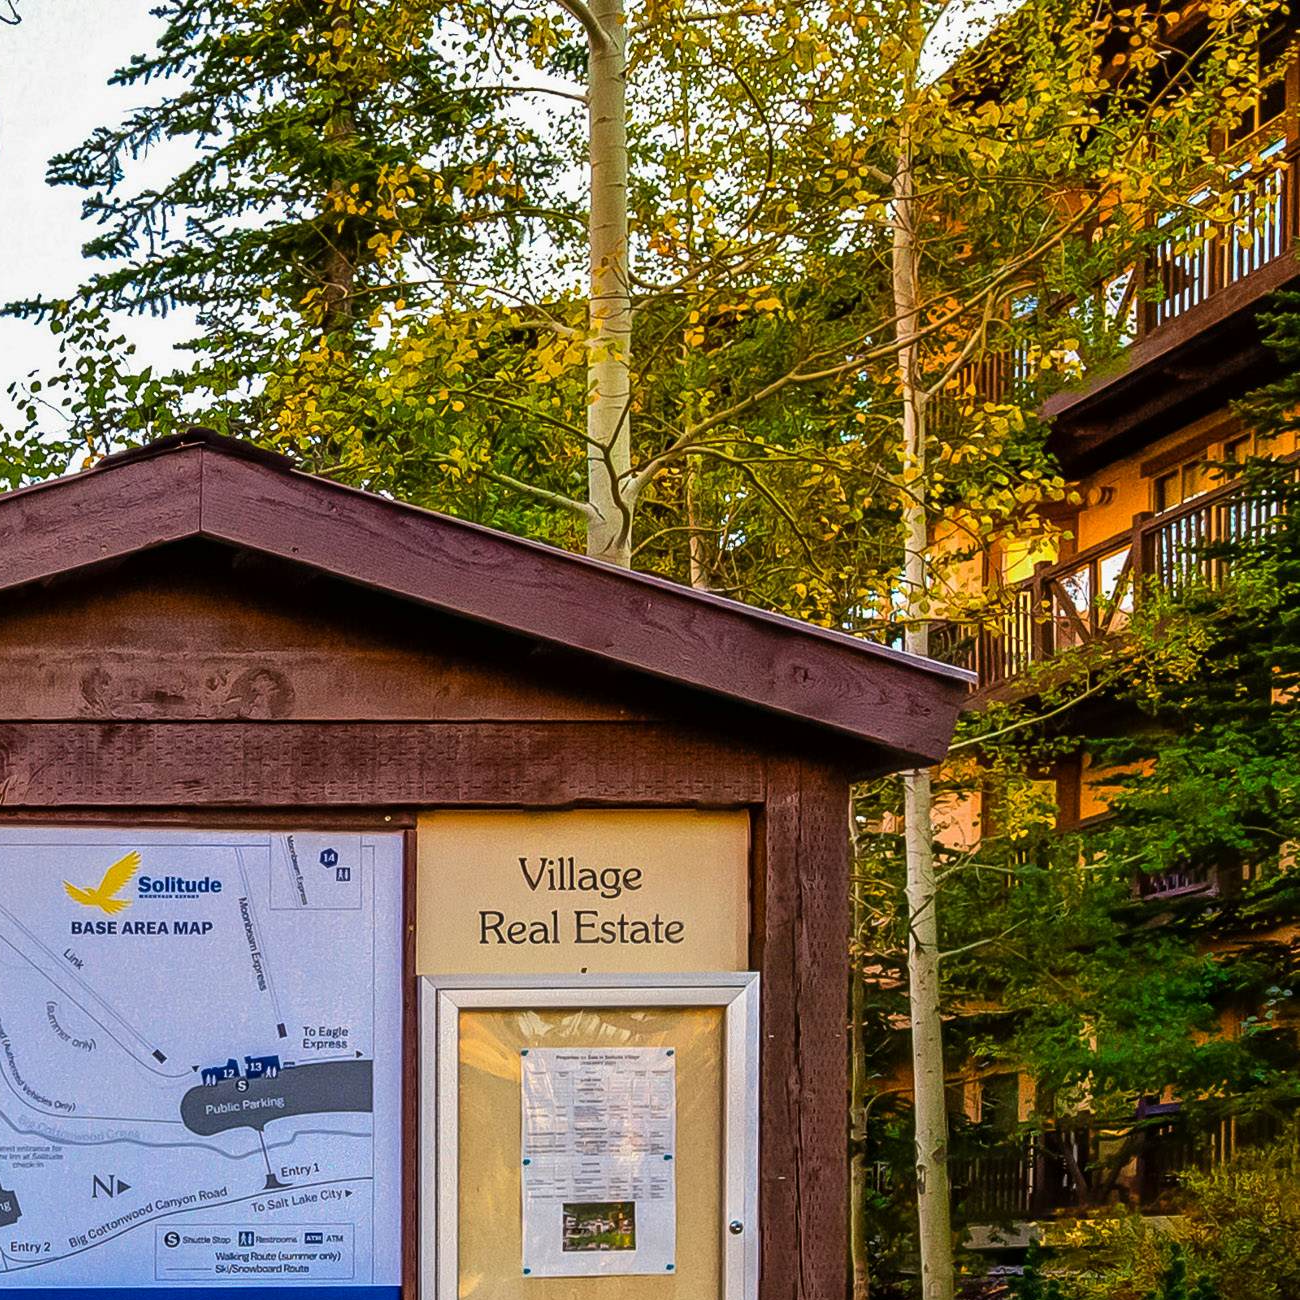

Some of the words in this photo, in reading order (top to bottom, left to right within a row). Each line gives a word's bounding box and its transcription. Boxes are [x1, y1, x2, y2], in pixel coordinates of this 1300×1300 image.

[324, 854, 336, 862] 14
[519, 857, 642, 898] Village
[138, 876, 222, 893] Solitude
[71, 921, 119, 935] BASE
[122, 921, 169, 935] AREA
[174, 921, 213, 935] MAP
[479, 910, 560, 944] Real
[574, 910, 684, 944] Estate
[239, 897, 256, 952] Moonbeam
[252, 952, 266, 992] Express
[63, 948, 84, 970] Link
[46, 1001, 70, 1042] (summer
[72, 1039, 96, 1052] only)
[303, 1026, 316, 1036] To
[319, 1026, 348, 1038] Eagle
[303, 1038, 348, 1050] Express
[250, 1062, 262, 1071] 13
[223, 1070, 234, 1078] 12
[205, 1100, 240, 1115] Public
[242, 1096, 285, 1111] Parking
[280, 1165, 312, 1178] Entry
[92, 1174, 115, 1198] N
[252, 1202, 265, 1212] To
[268, 1199, 290, 1210] Salt
[292, 1193, 318, 1207] Lake
[320, 1188, 343, 1202] City
[68, 1233, 88, 1248] Big
[88, 1204, 153, 1240] Cottonwood
[155, 1194, 197, 1212] Canyon
[198, 1186, 228, 1200] Road
[182, 1236, 210, 1244] Shuttle
[212, 1236, 231, 1245] Stop
[256, 1236, 298, 1244] Restrooms
[326, 1234, 343, 1242] ATM
[10, 1241, 41, 1254] Entry
[44, 1242, 50, 1251] 2
[215, 1252, 249, 1264] Walking
[250, 1252, 276, 1261] Route
[278, 1252, 316, 1262] (summer
[319, 1252, 341, 1263] only)
[215, 1264, 282, 1274] Ski/Snowboard
[284, 1264, 309, 1273] Route
